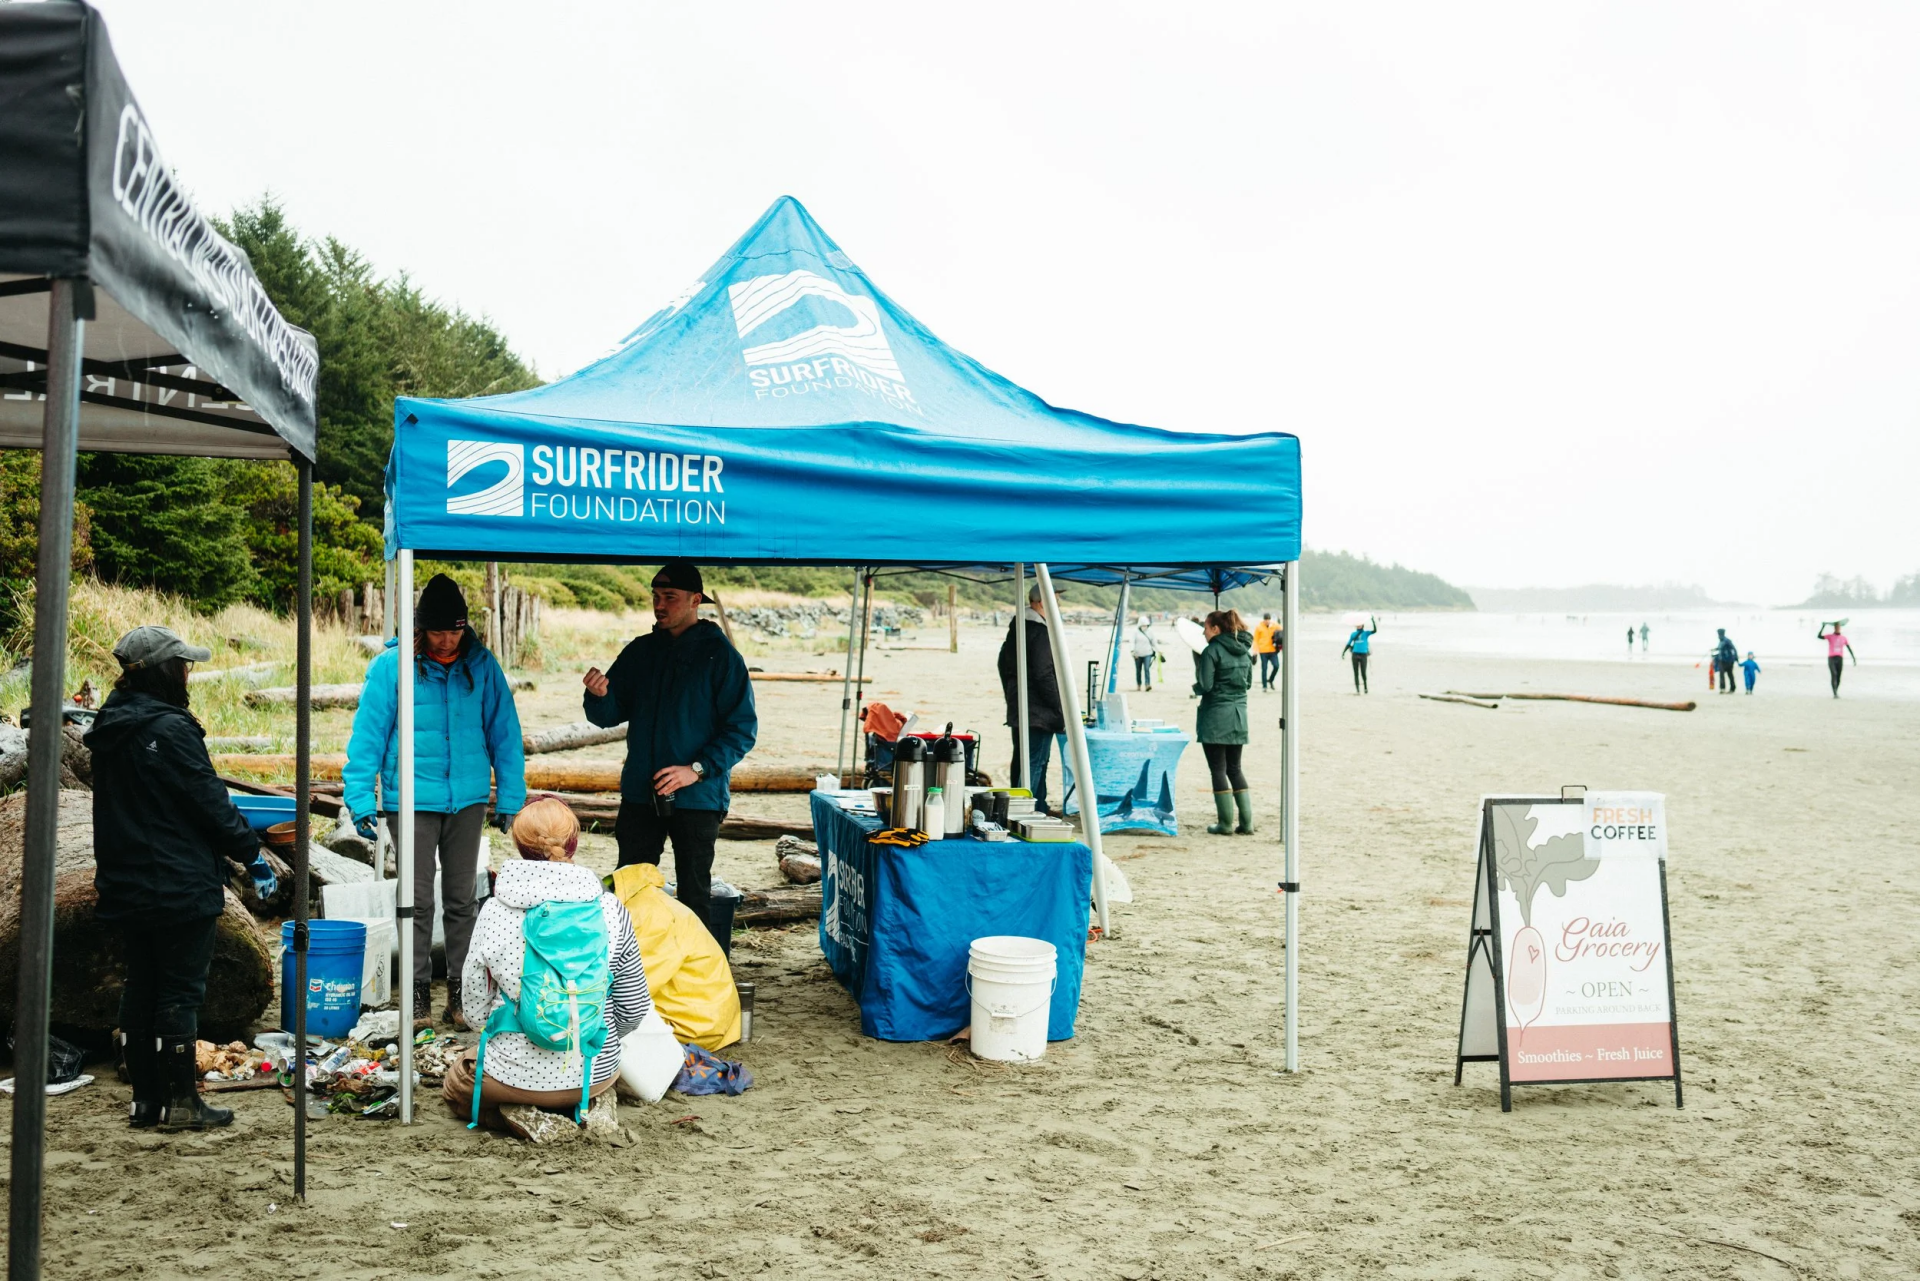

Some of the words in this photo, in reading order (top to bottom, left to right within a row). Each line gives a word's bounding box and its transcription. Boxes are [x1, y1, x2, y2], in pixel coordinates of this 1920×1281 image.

[113, 103, 199, 275] CENTRAL
[749, 356, 918, 404] SURFRIDER
[754, 376, 925, 417] FOUNDATION
[531, 444, 726, 494] SURFRIDER
[530, 492, 726, 525] FOUNDATION
[1592, 807, 1653, 824] FRESH
[1591, 825, 1657, 840] COFFEE
[1561, 917, 1631, 944] Gaia
[1555, 935, 1661, 973] Grocery
[1581, 981, 1633, 998] OPEN
[1556, 1005, 1595, 1015] PARKING
[1596, 1004, 1636, 1014] AROUND
[1638, 1003, 1662, 1013] BACK
[1518, 1047, 1582, 1064] Smoothies
[1597, 1047, 1630, 1061] Fresh
[1633, 1046, 1663, 1062] Juice
